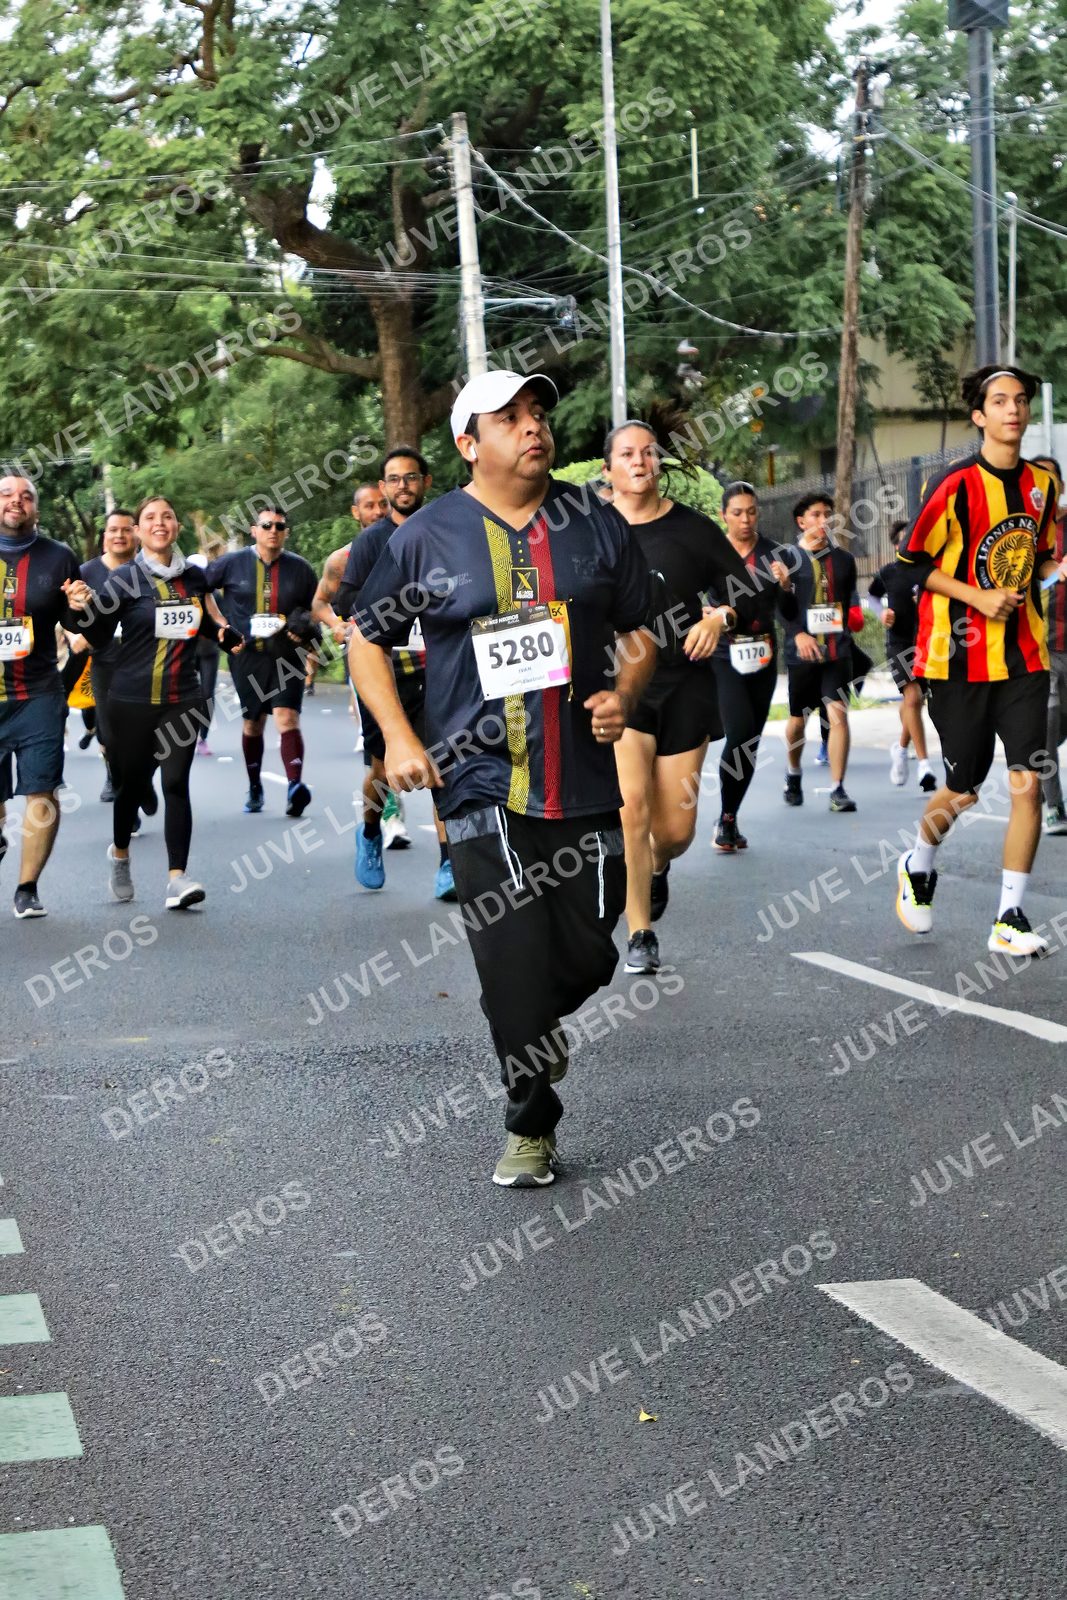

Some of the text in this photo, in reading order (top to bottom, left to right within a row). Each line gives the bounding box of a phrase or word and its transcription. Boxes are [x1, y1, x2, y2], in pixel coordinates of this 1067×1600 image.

[978, 519, 1014, 560] LEONES
[162, 611, 194, 626] 3395
[489, 631, 554, 669] 5280
[738, 646, 765, 661] 1170
